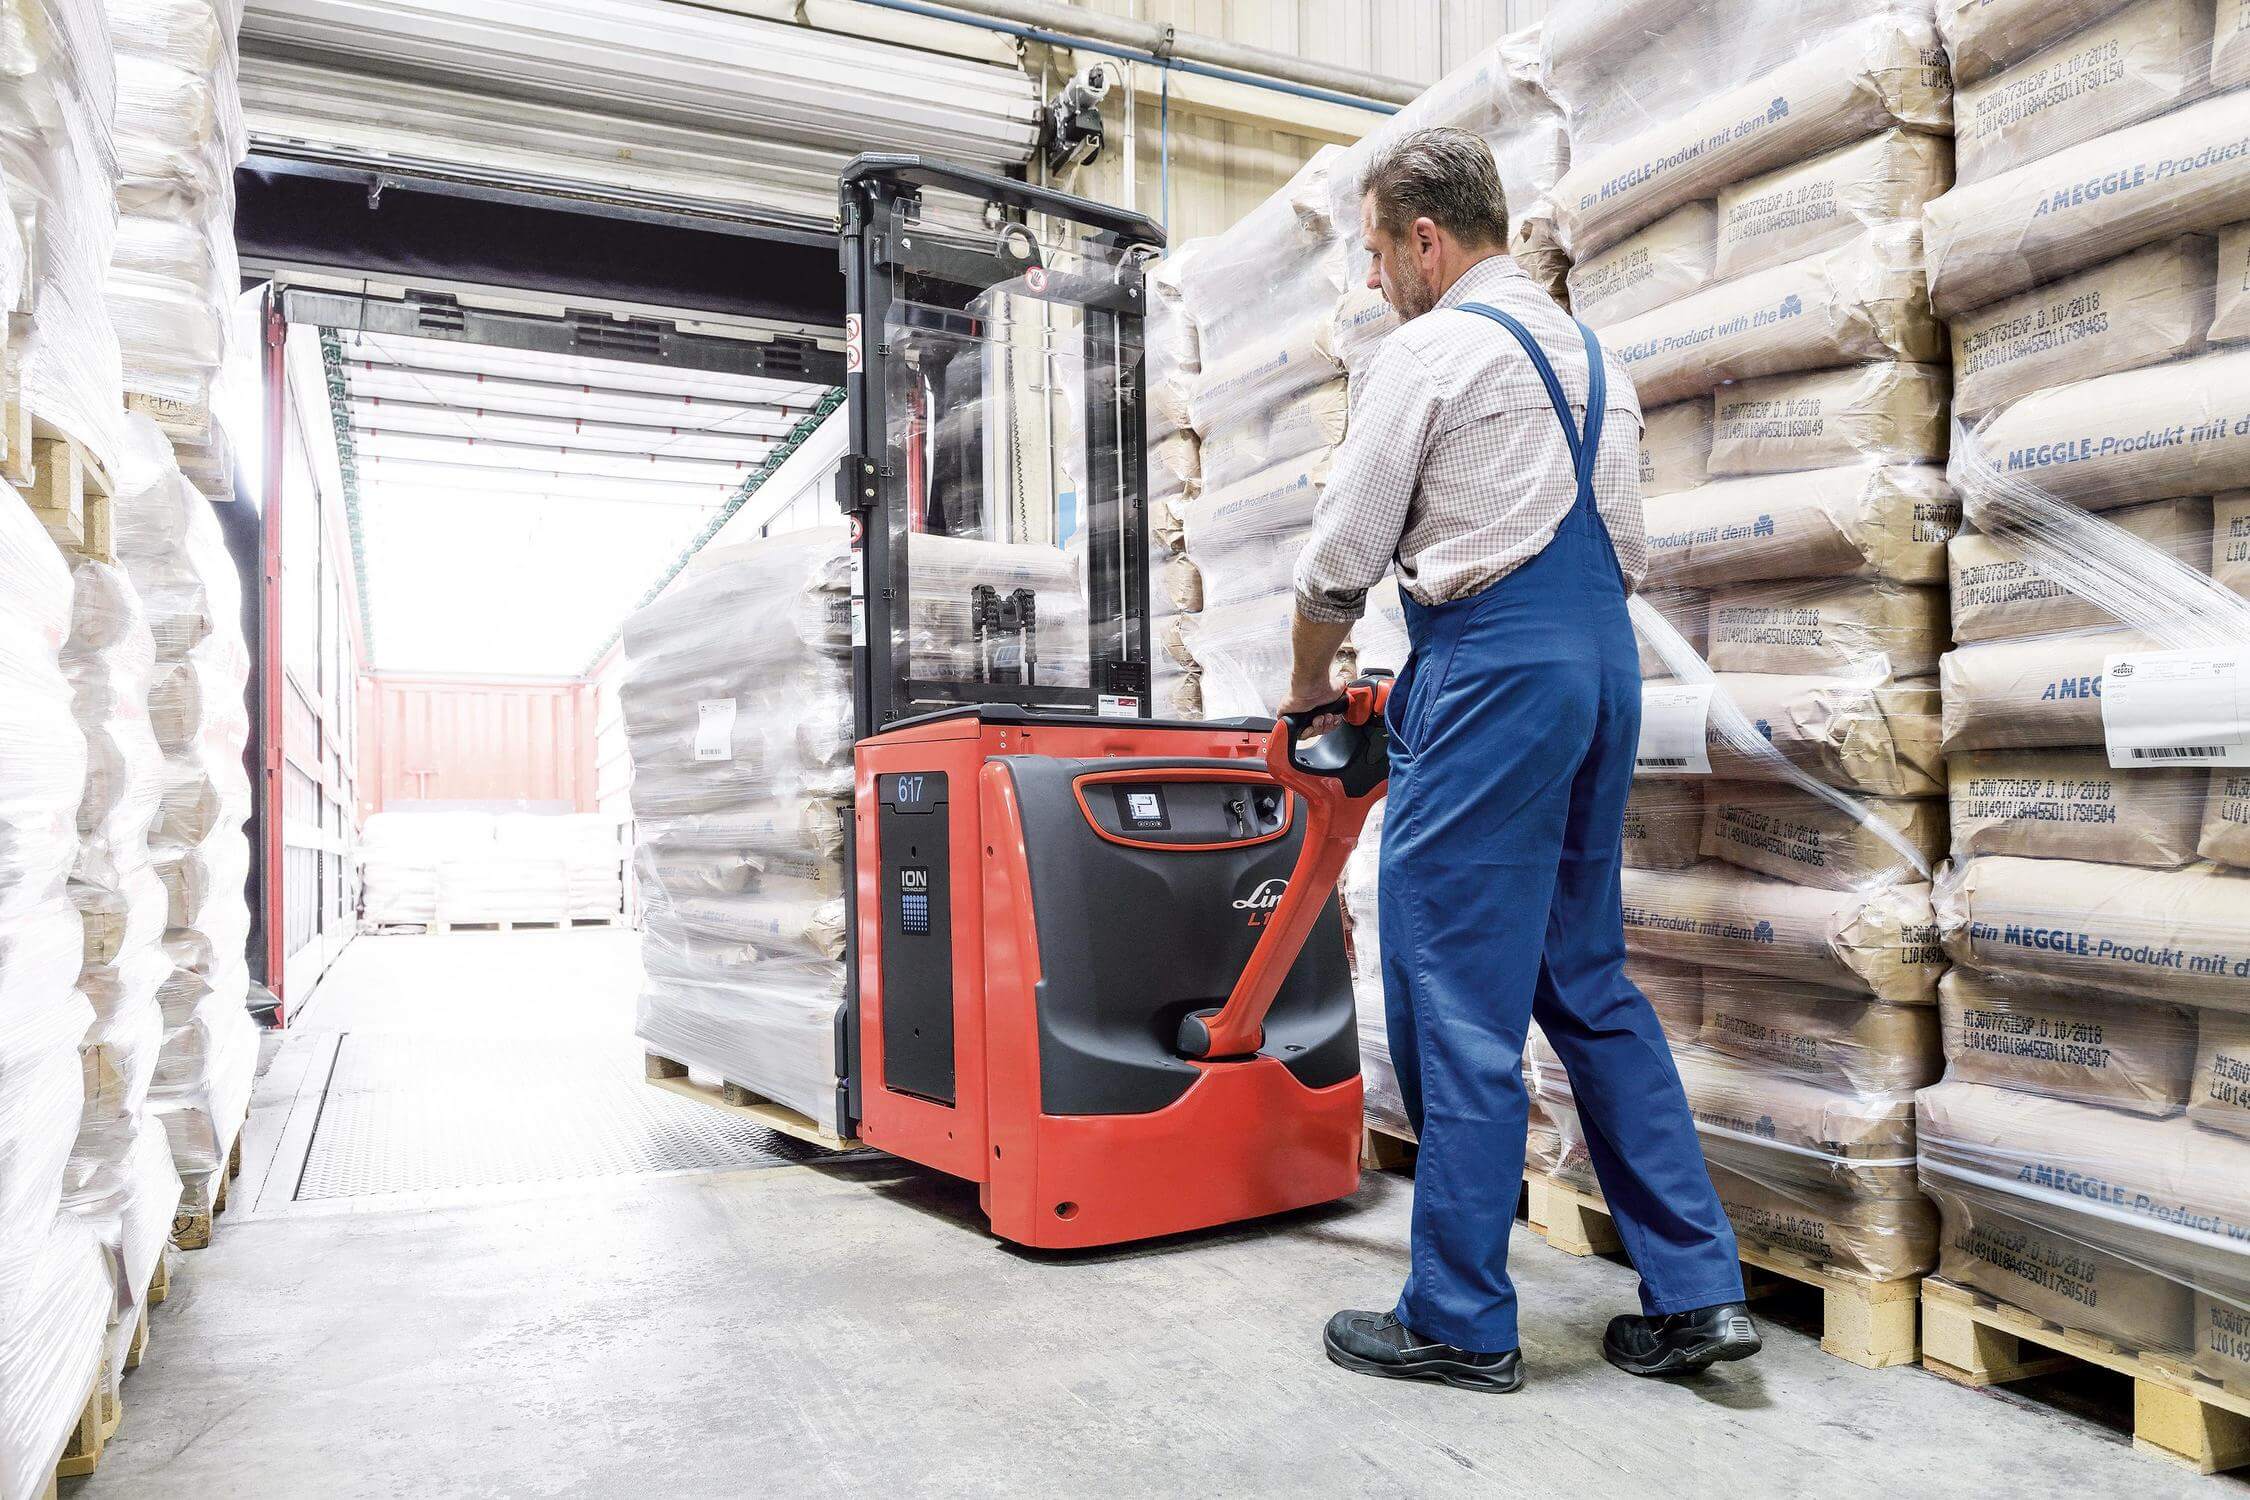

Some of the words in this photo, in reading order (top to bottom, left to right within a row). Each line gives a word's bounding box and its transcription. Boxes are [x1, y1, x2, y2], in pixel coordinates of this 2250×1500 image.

[1580, 192, 1598, 211] Ein
[1600, 139, 1706, 202] MEGGLE-Produkt
[1708, 128, 1732, 151] mit
[1734, 116, 1766, 142] dem
[1718, 315, 1748, 337] with
[1752, 309, 1777, 328] the
[2008, 425, 2185, 472] MEGGLE-Produkt
[2190, 418, 2226, 443] mit
[1695, 527, 1719, 543] mit
[1721, 524, 1752, 541] dem
[2041, 683, 2056, 701] A
[898, 776, 924, 803] 617
[901, 870, 927, 887] ION
[1699, 920, 1721, 936] mit
[1722, 923, 1752, 941] dem
[1971, 921, 1998, 942] Ein
[2004, 923, 2184, 970] MEGGLE-Produkt
[2189, 953, 2227, 975] mit
